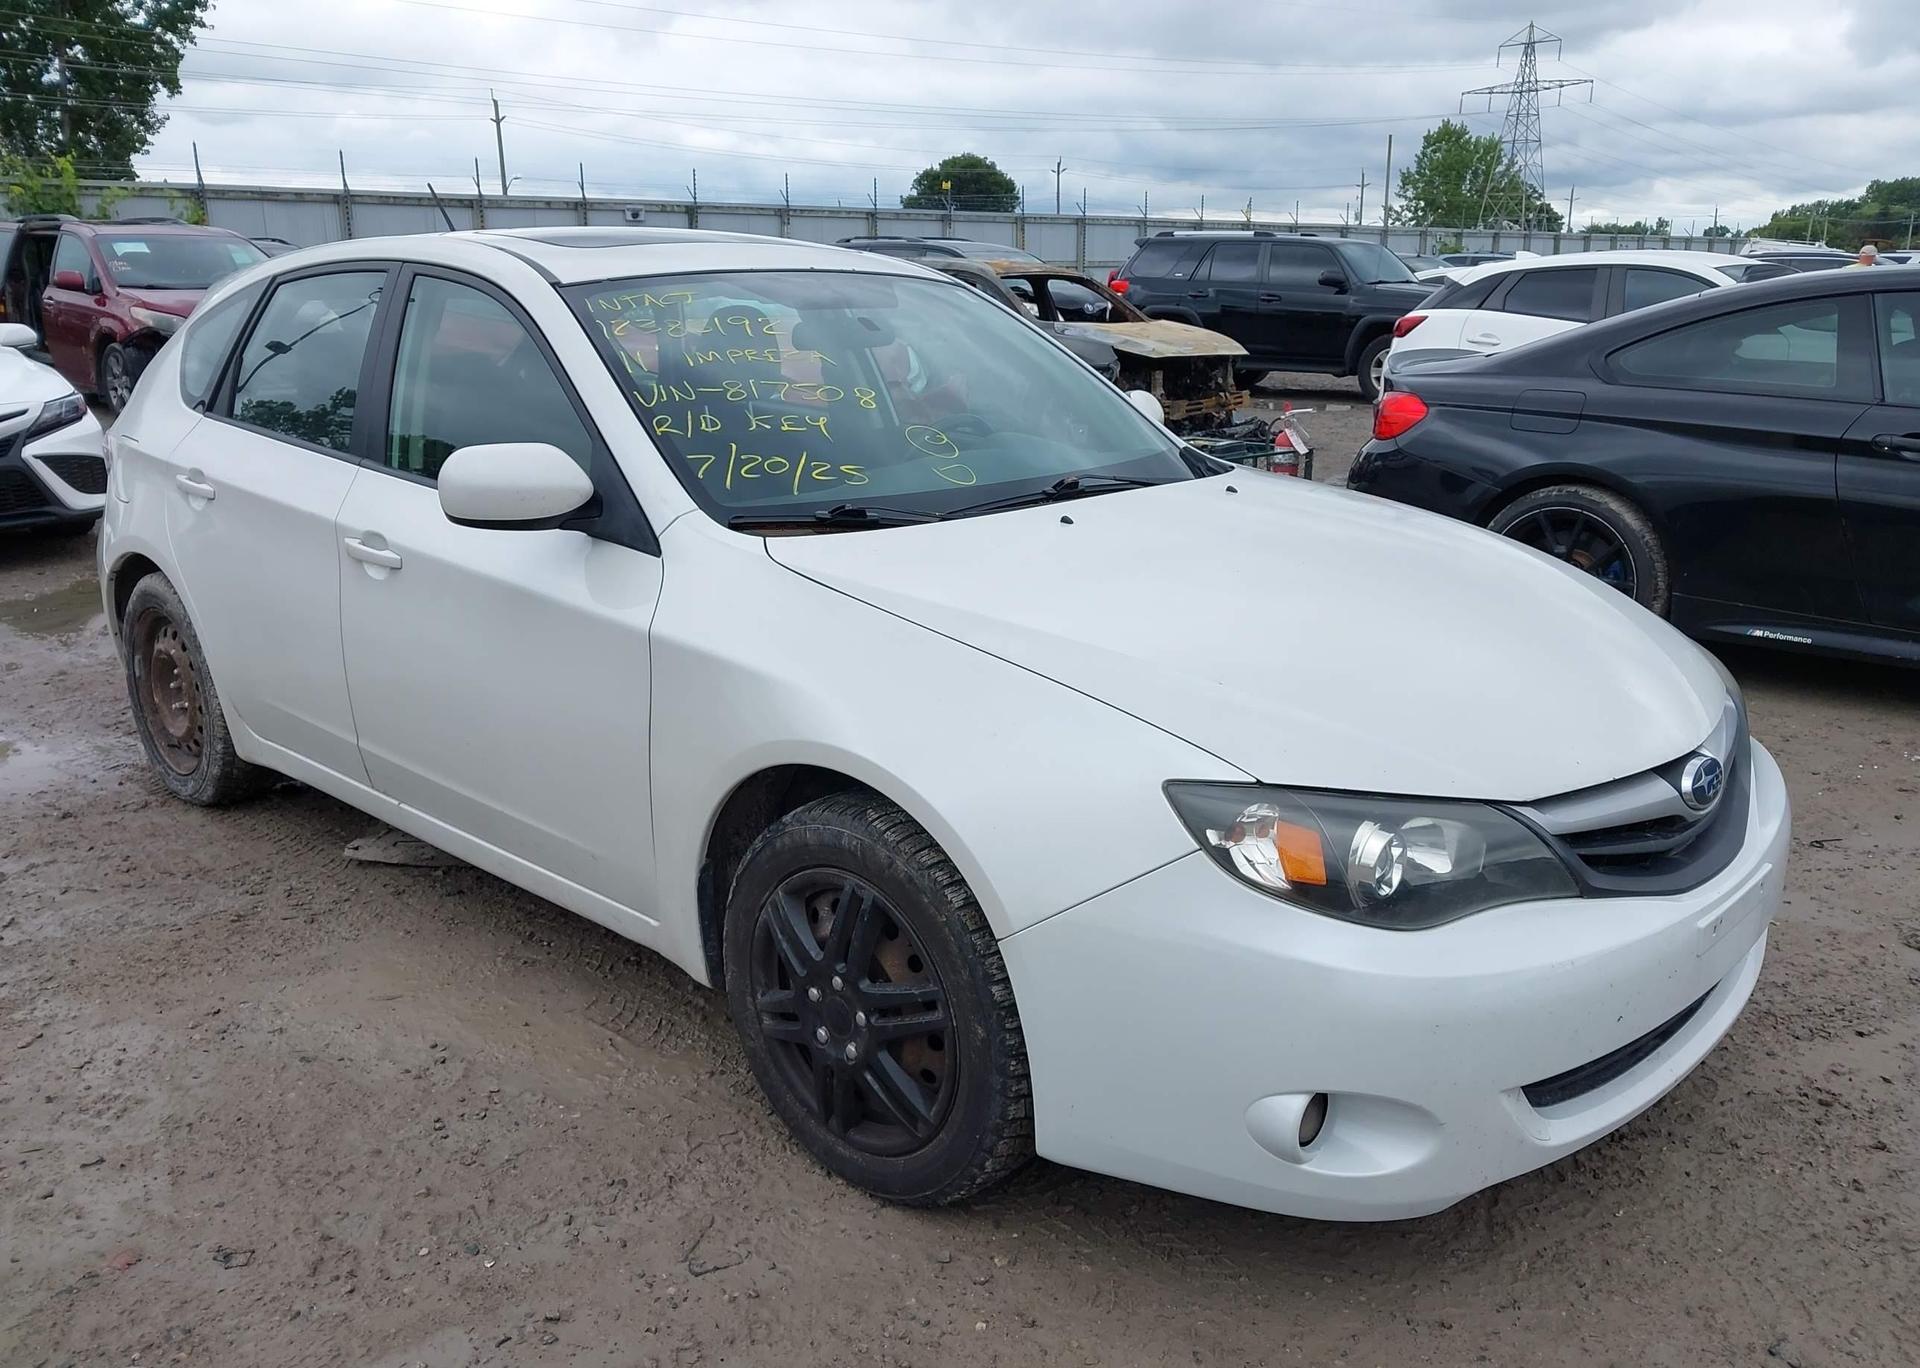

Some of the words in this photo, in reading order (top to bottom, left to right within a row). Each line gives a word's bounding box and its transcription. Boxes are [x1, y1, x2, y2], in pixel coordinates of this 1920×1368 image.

[584, 291, 699, 313] INTACT
[745, 401, 834, 444] KEY
[685, 442, 870, 496] 7/20/25
[1764, 630, 1812, 644] Performance
